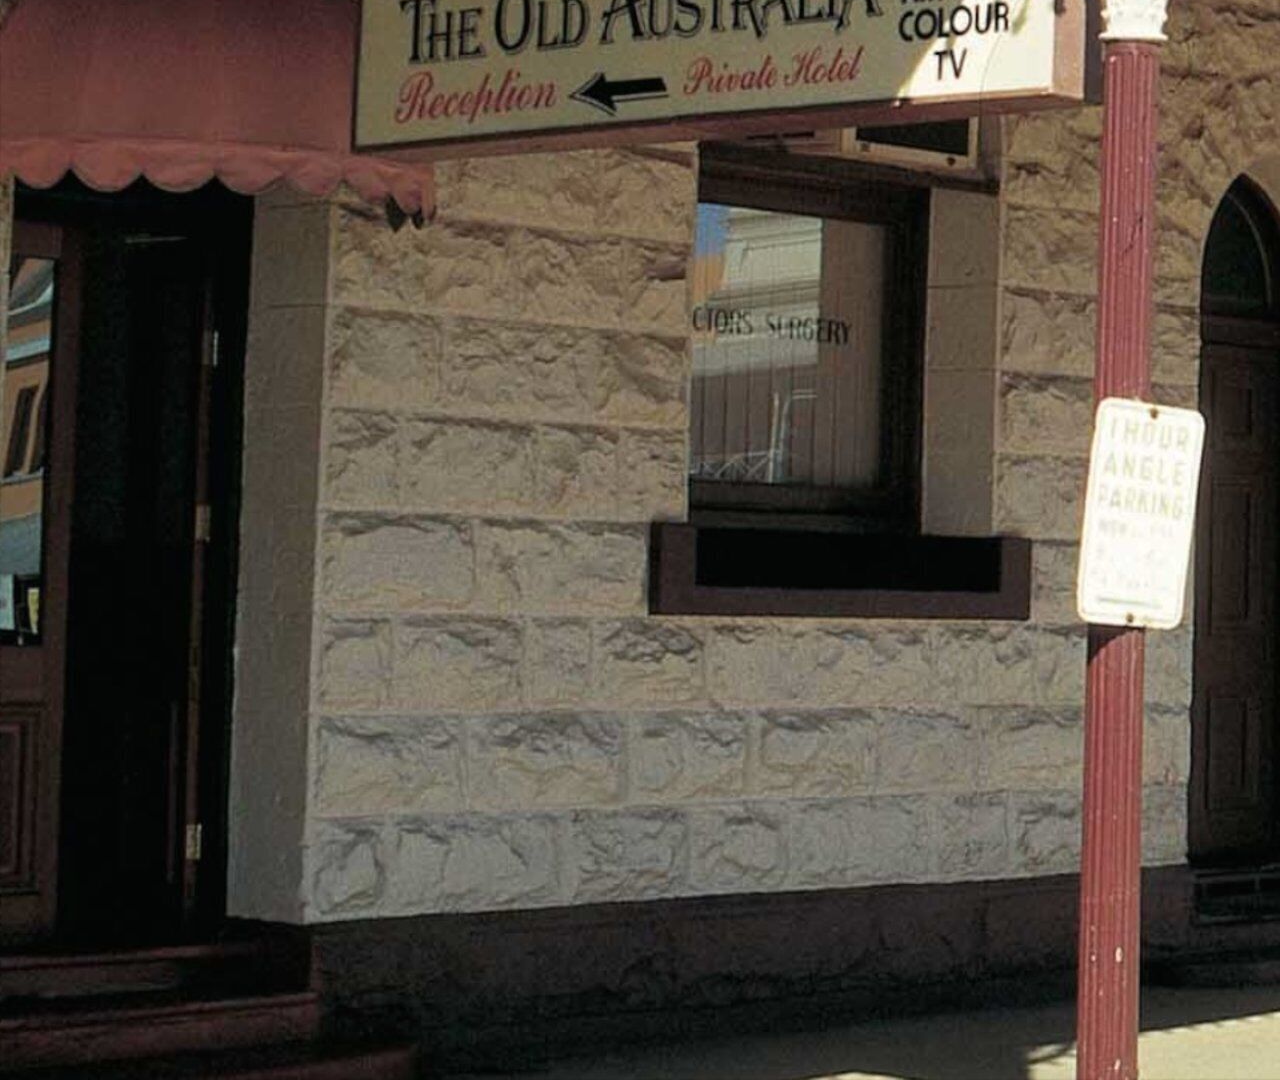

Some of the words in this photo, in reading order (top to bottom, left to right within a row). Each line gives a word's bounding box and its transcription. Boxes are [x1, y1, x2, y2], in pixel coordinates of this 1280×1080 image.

[898, 1, 1010, 42] COLOUR
[683, 54, 777, 96] Private
[784, 45, 865, 88] Hotel
[933, 48, 968, 81] TV
[394, 70, 558, 124] Reception
[766, 313, 852, 345] SURGERY
[1122, 416, 1190, 454] HOUR
[1102, 450, 1188, 487] ANGLE
[1098, 482, 1185, 520] PARKING
